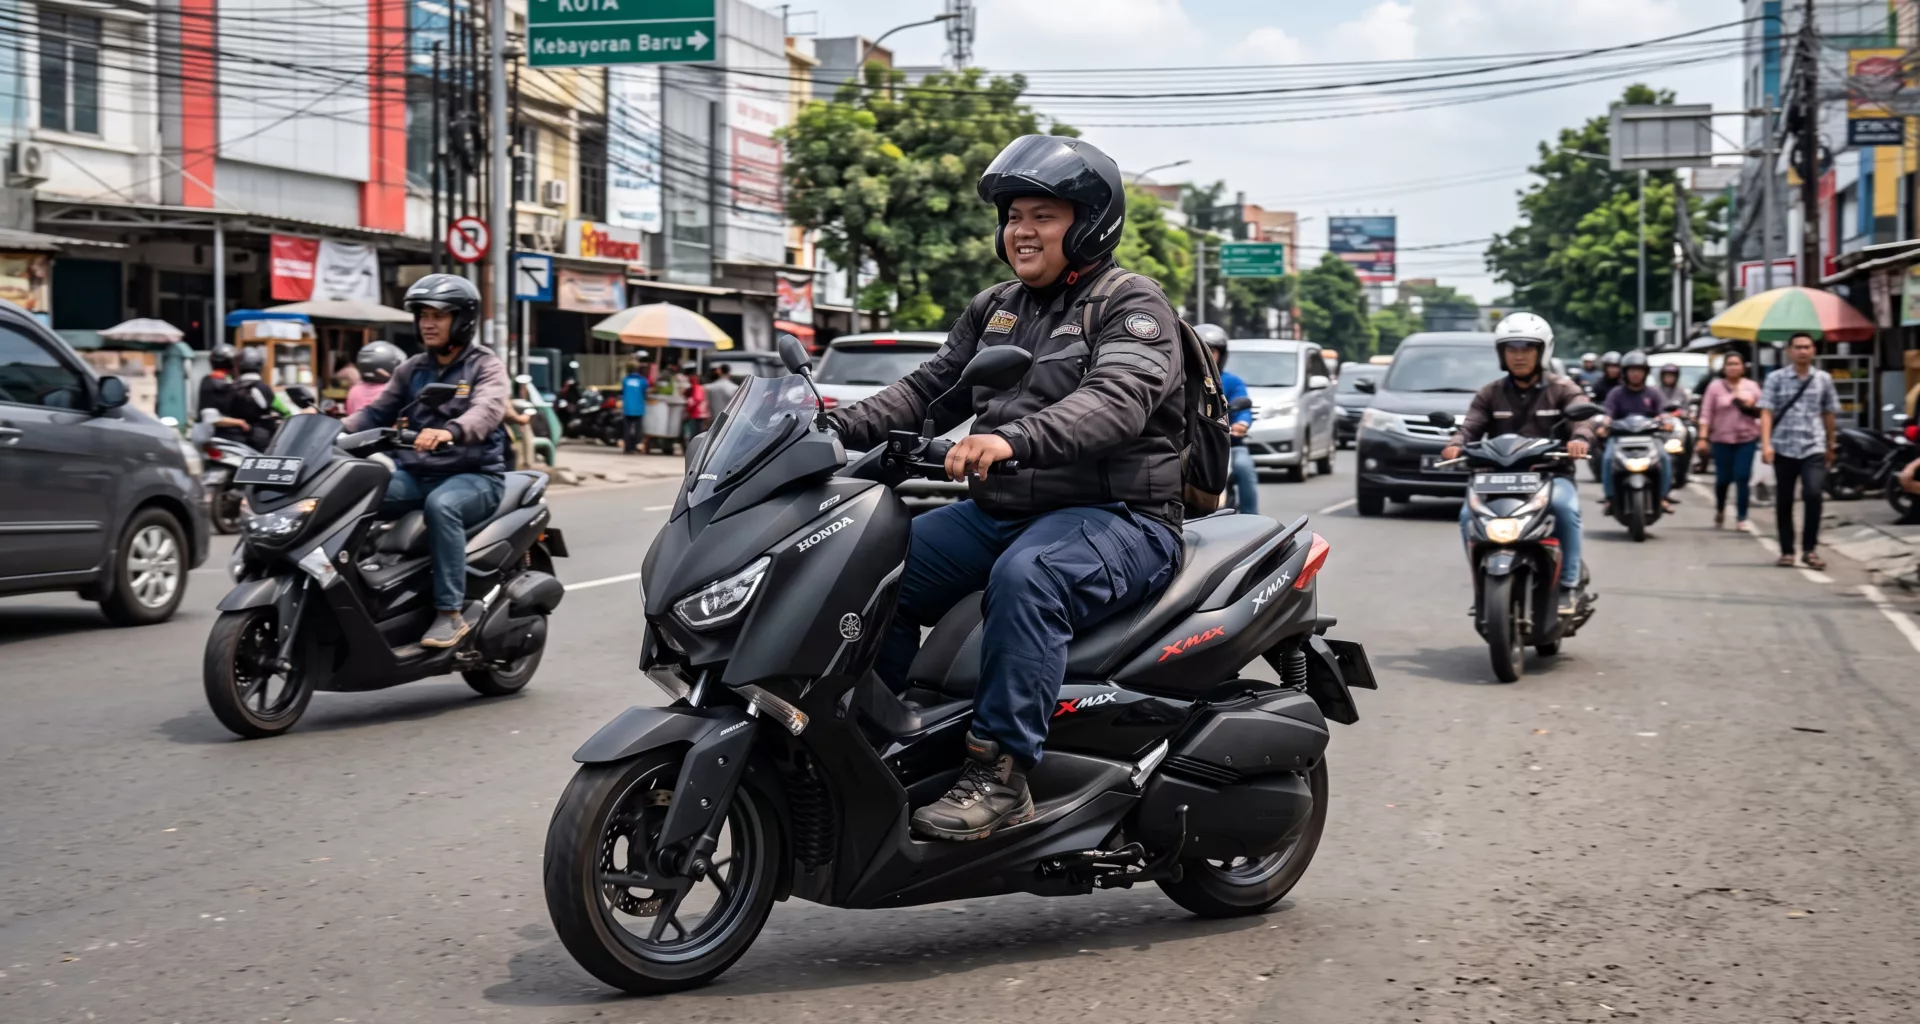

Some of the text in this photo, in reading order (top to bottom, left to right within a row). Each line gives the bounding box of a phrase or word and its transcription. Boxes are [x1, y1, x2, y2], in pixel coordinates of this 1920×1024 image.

[533, 34, 683, 58] Kebayoran Baru
[796, 516, 855, 553] HONDA
[1251, 570, 1291, 616] XMAX
[1157, 625, 1226, 663] XMAX
[1053, 691, 1118, 717] XMAX
